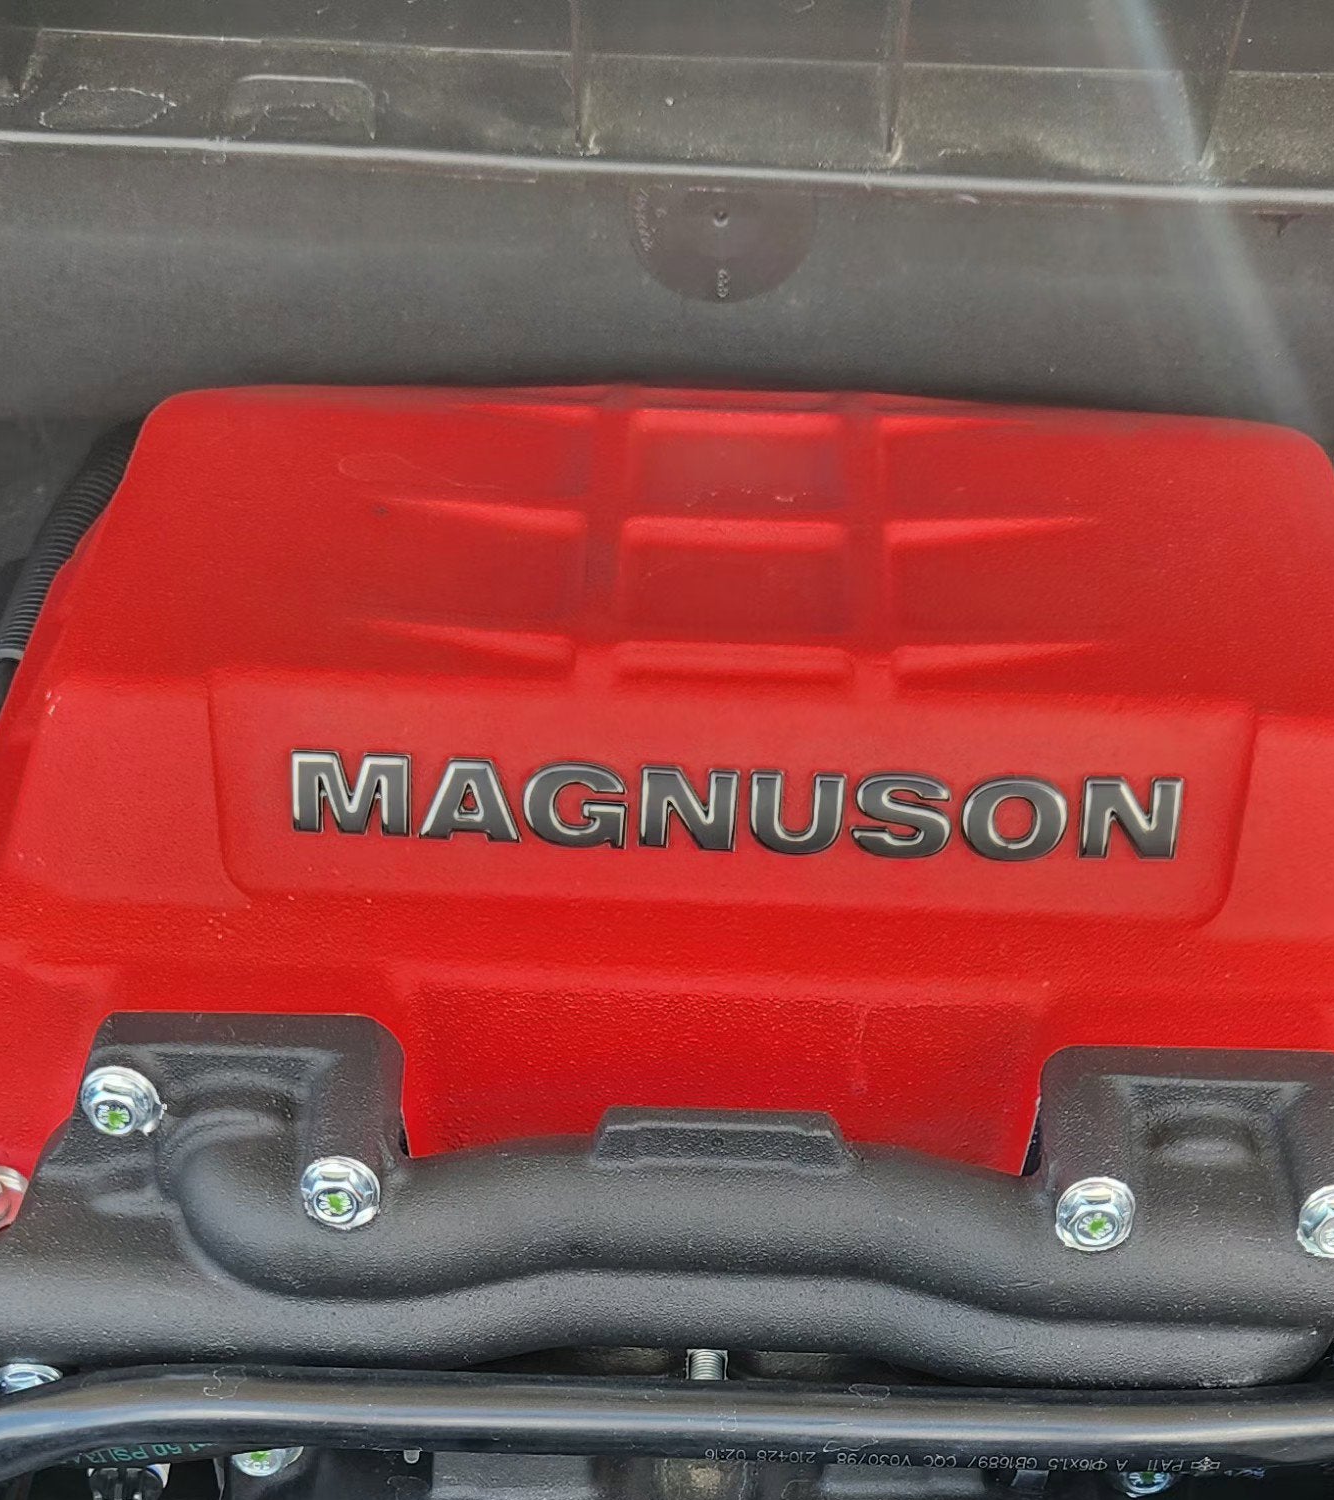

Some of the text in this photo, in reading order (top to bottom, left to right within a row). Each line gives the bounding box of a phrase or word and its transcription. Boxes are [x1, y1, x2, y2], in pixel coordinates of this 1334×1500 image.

[290, 747, 1185, 862] MAGNUSON
[756, 1449, 817, 1465] 210428
[922, 1454, 957, 1467] CQC
